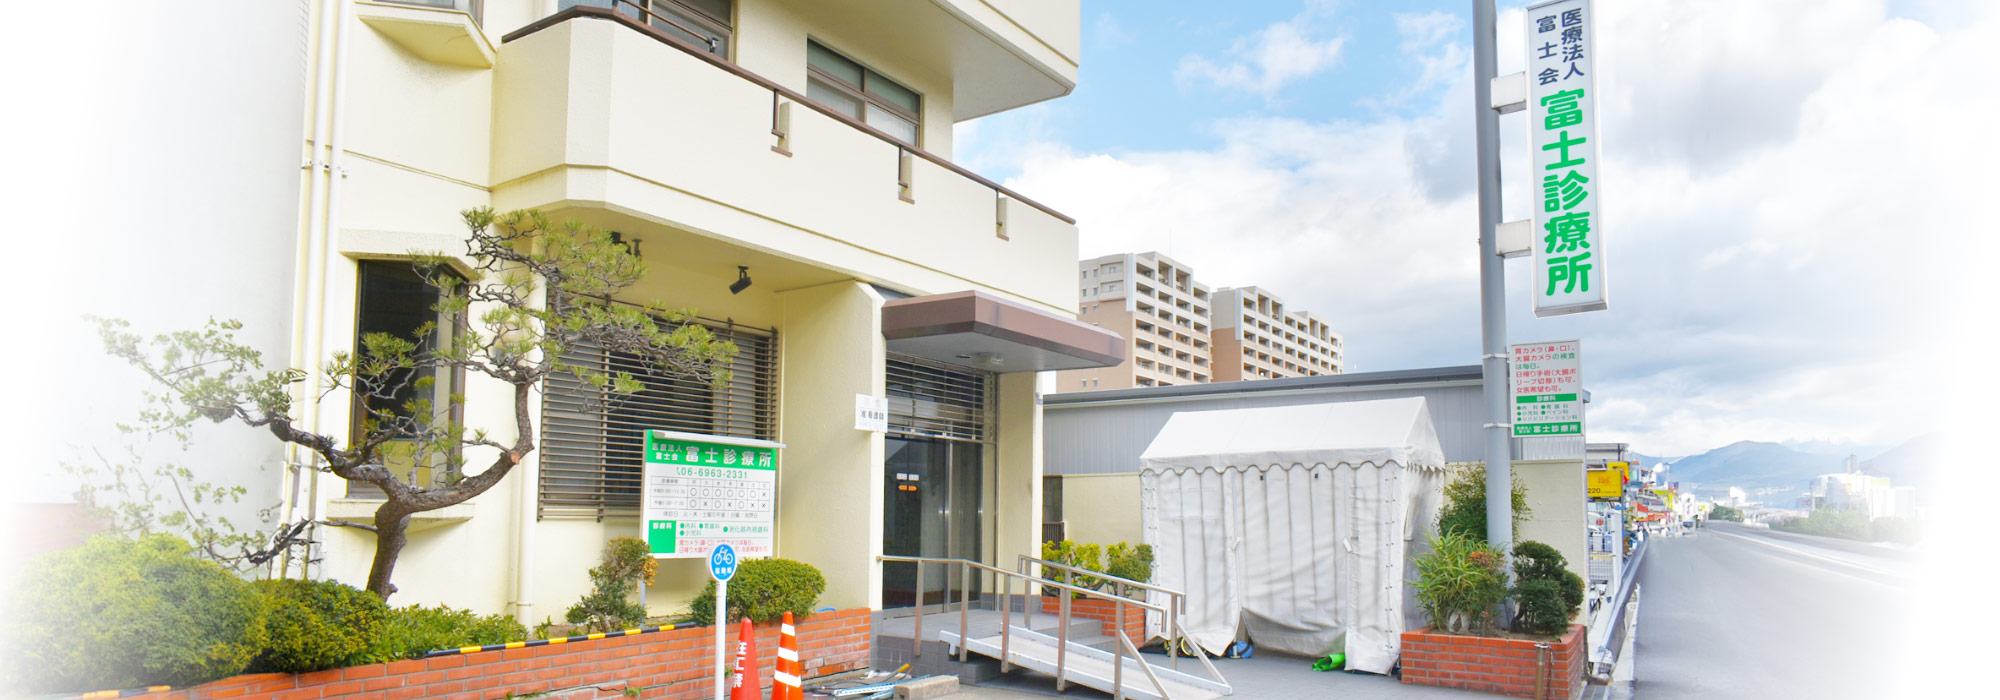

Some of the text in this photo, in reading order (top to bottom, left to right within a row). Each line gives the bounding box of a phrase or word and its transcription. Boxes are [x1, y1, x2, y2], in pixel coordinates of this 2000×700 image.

[1536, 15, 1559, 86] 富士会
[1561, 7, 1585, 80] 医療法人
[1540, 88, 1593, 297] 富士診療所
[1533, 424, 1579, 433] 富士診療所
[656, 452, 678, 461] 富士会
[685, 446, 772, 468] 富士診療所
[681, 467, 748, 479] 06-6963-2331
